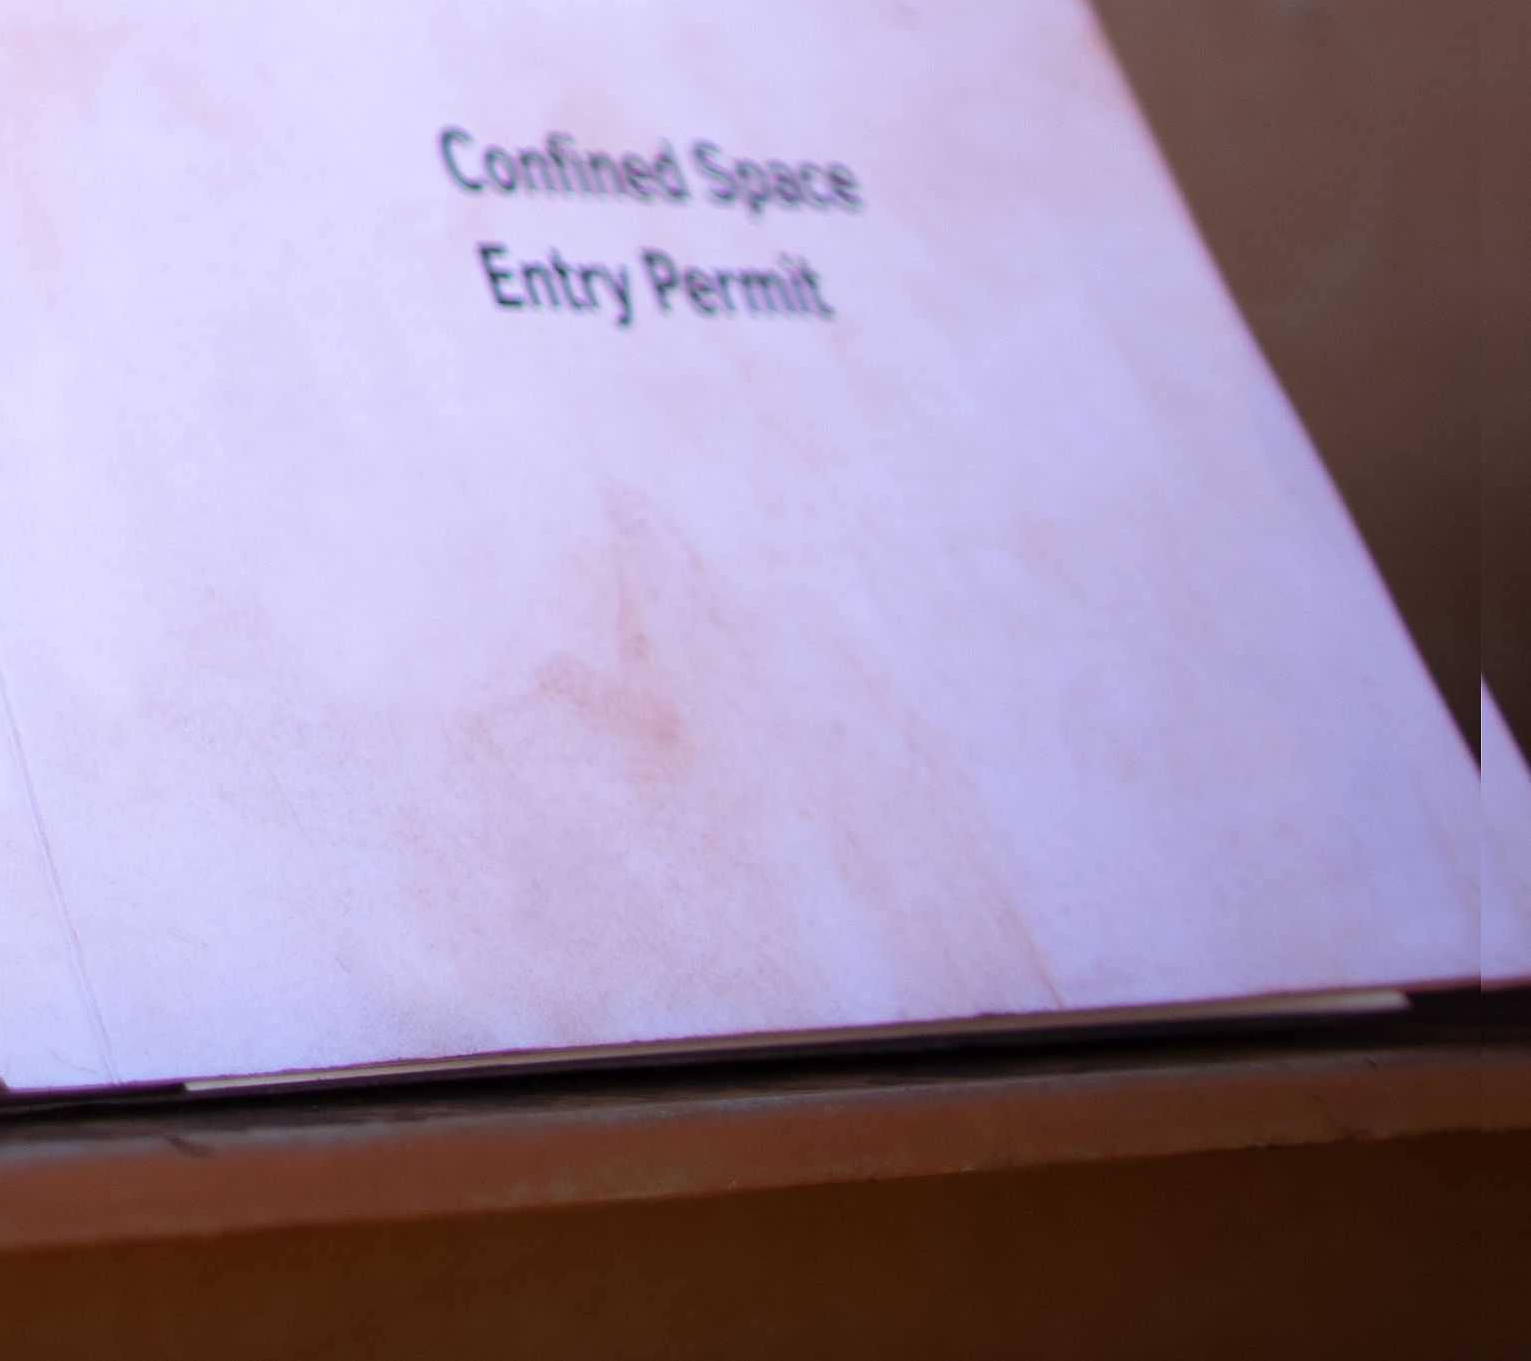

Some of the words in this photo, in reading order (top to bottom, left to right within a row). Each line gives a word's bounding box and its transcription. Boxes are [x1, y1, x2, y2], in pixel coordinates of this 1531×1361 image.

[437, 125, 690, 206] Confined
[691, 137, 866, 221] Space
[474, 240, 637, 329] Entry
[639, 245, 839, 323] Permit
